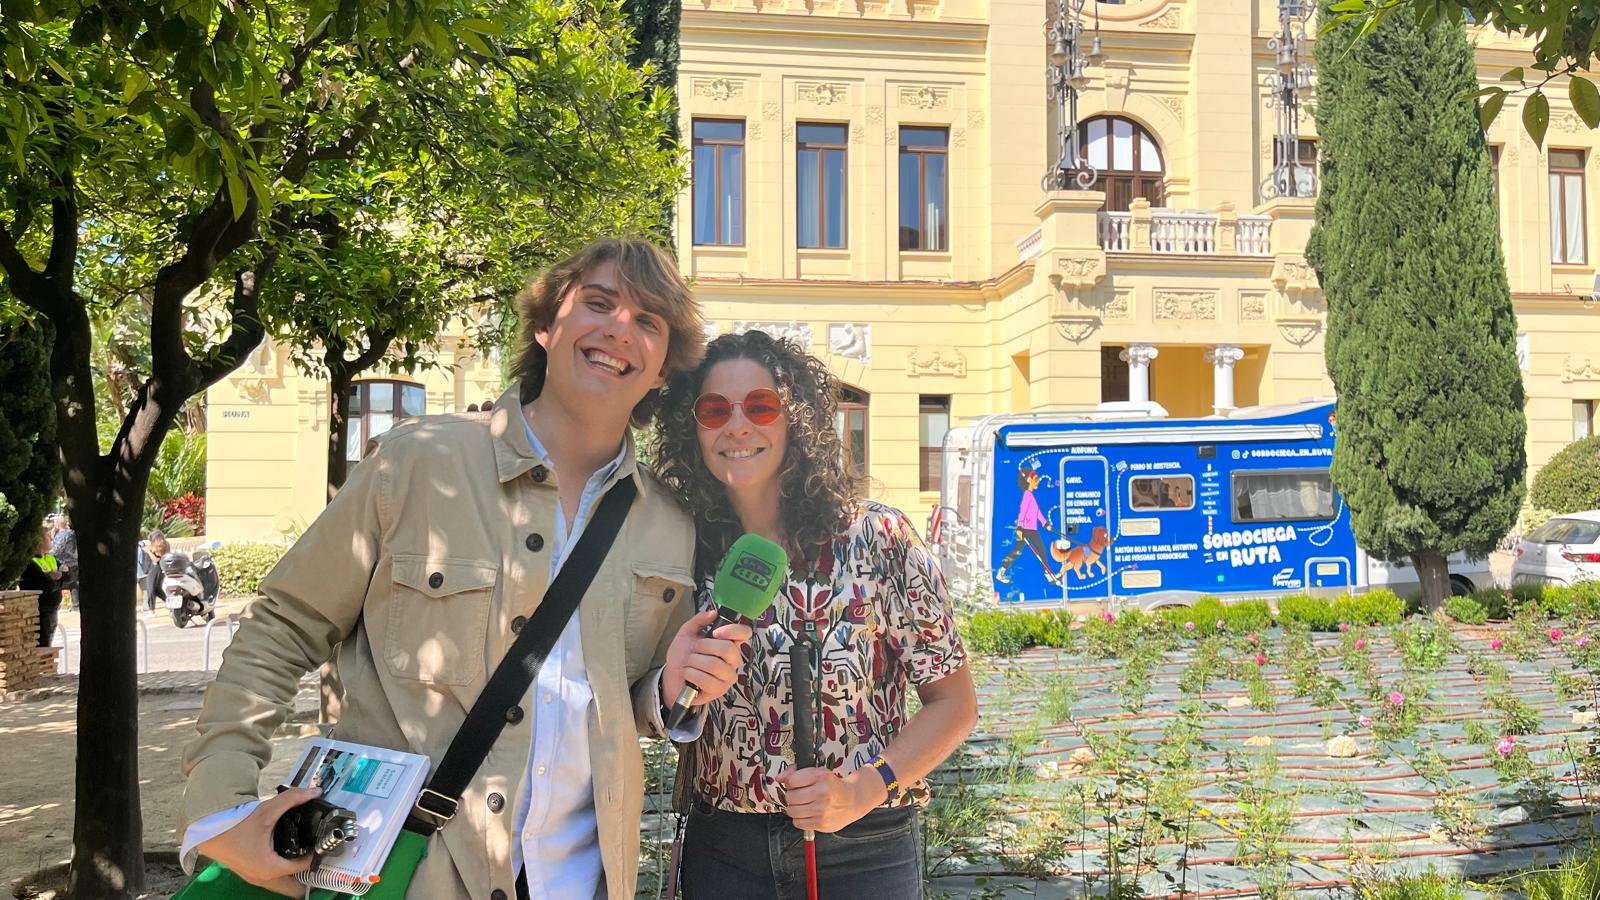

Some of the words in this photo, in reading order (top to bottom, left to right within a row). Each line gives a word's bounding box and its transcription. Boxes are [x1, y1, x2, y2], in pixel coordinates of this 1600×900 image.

[1203, 525, 1297, 550] SORDOCIEGA
[1134, 545, 1147, 553] ROJO
[1172, 543, 1198, 551] DISTINTIVO
[1115, 554, 1121, 562] DE
[1132, 553, 1156, 561] PERSONAS
[1216, 550, 1229, 561] EN
[1230, 545, 1282, 567] RUTA
[739, 569, 765, 584] CERO
